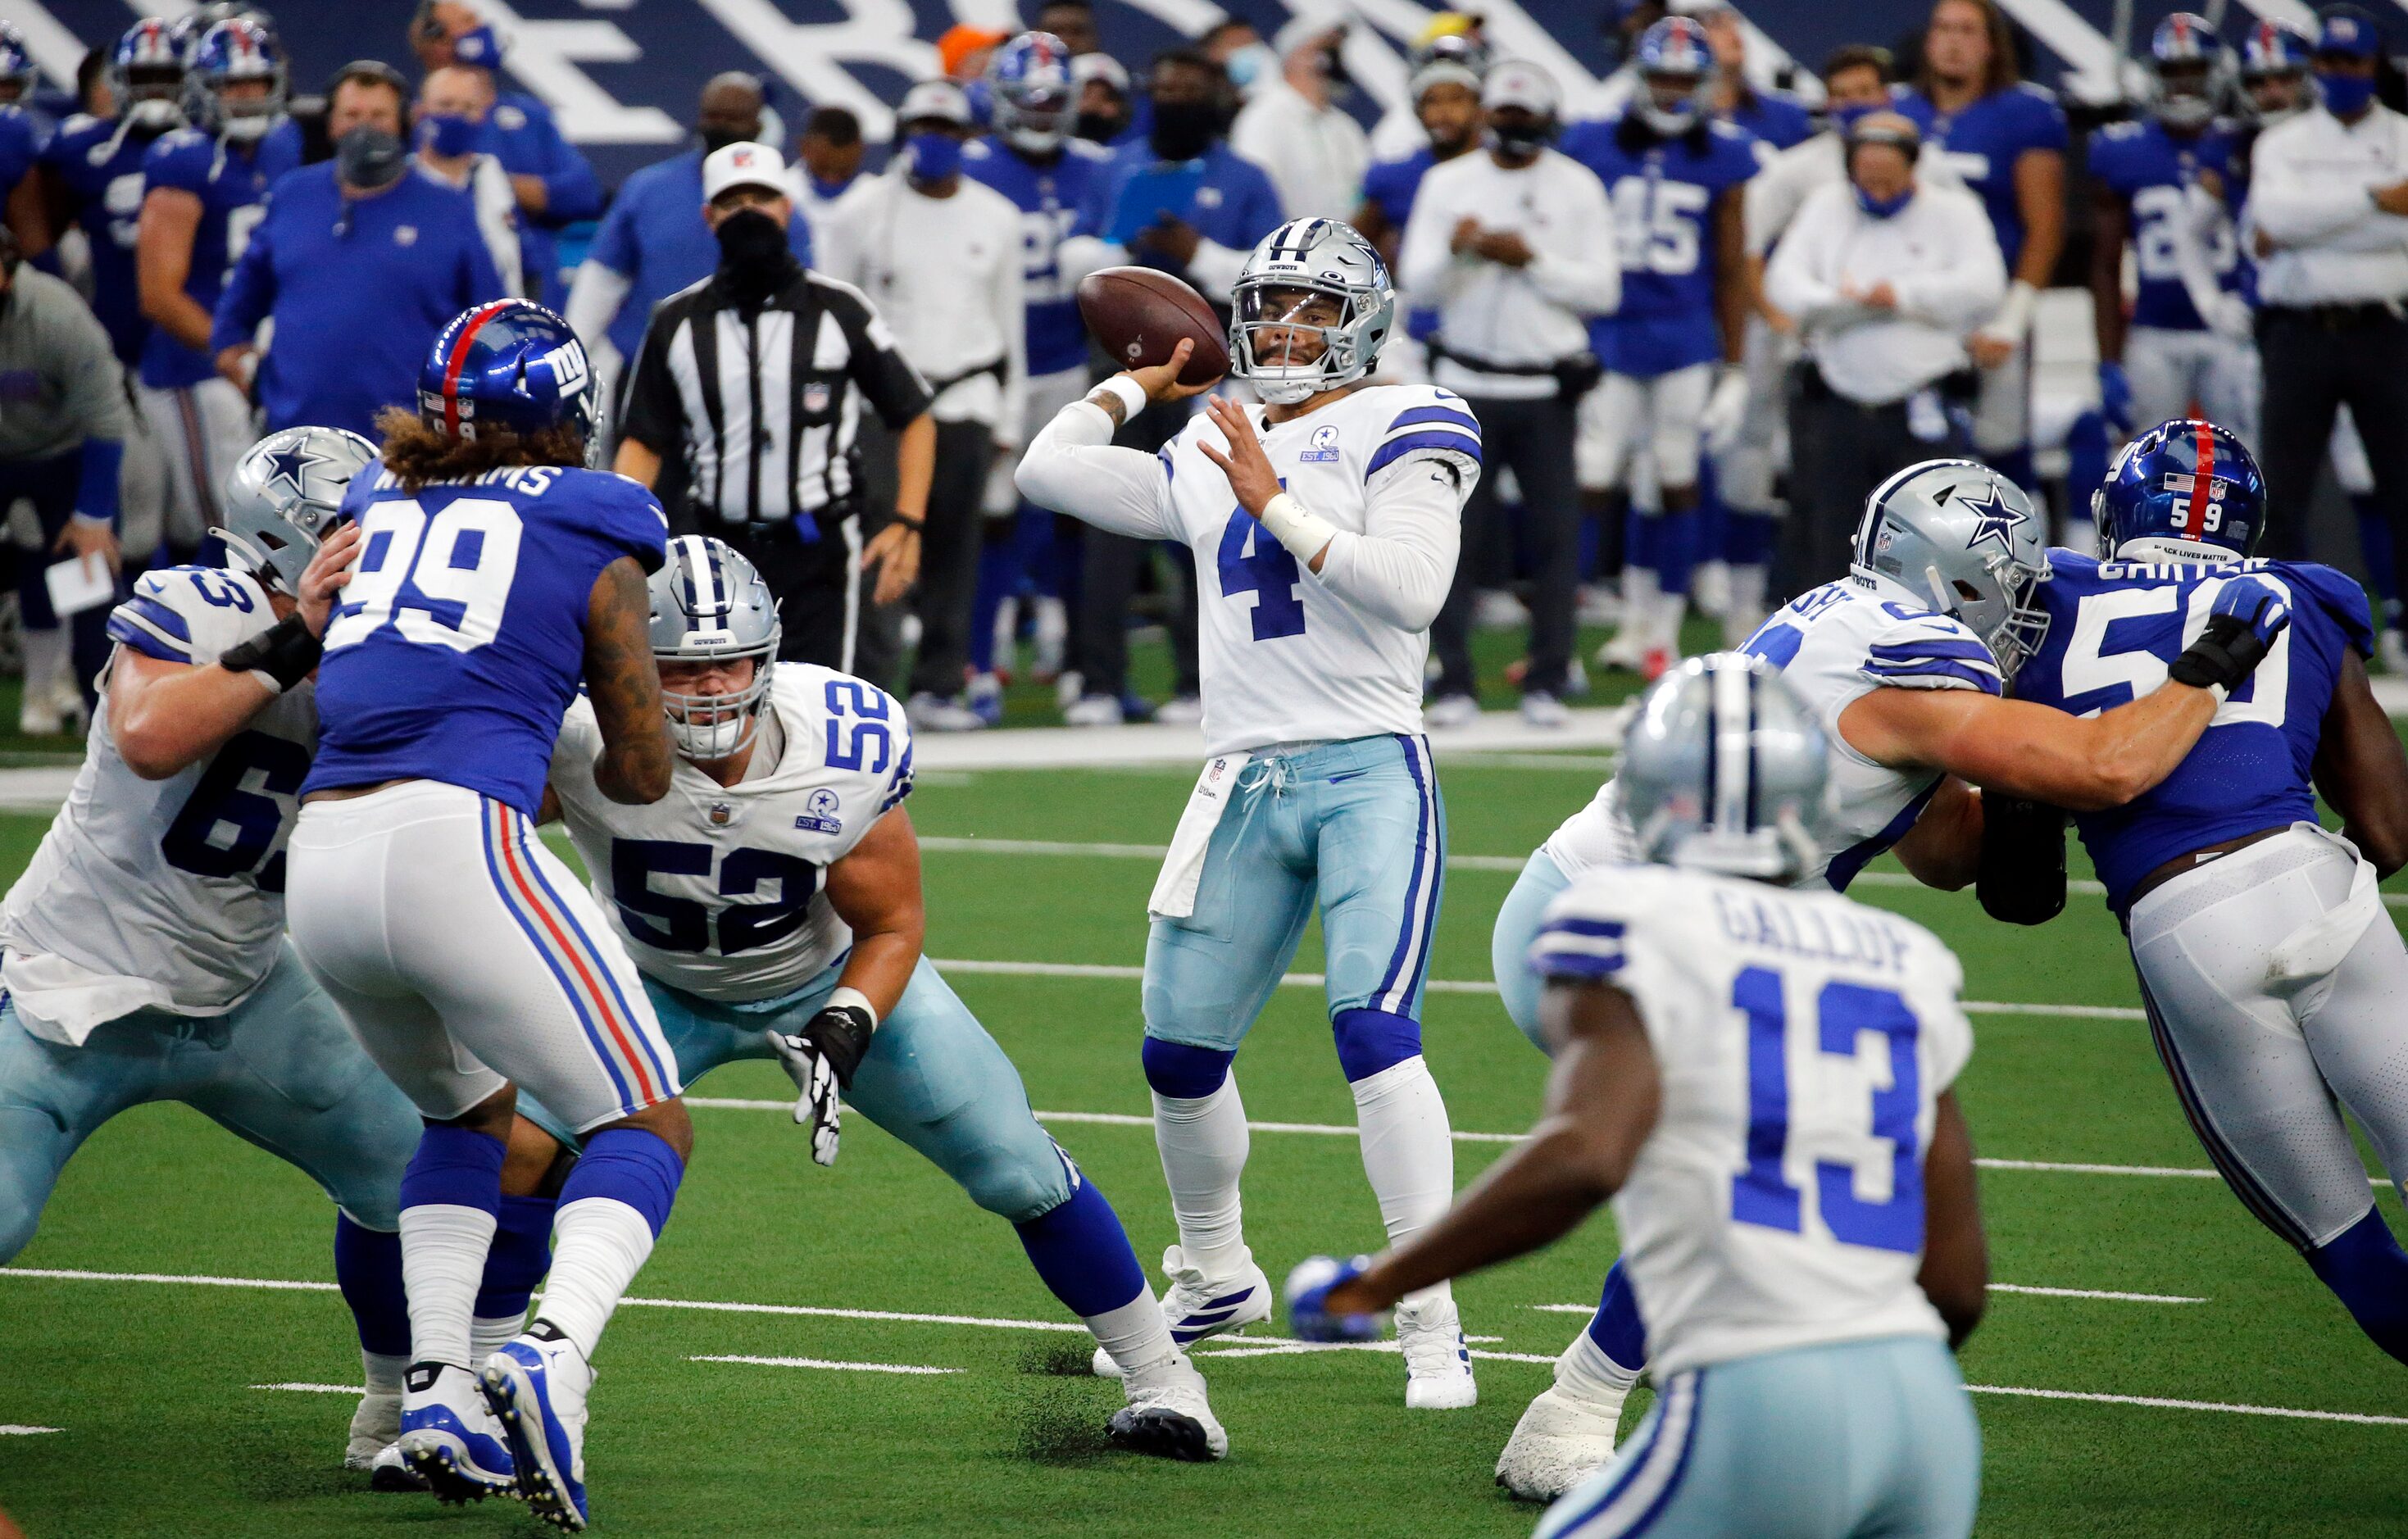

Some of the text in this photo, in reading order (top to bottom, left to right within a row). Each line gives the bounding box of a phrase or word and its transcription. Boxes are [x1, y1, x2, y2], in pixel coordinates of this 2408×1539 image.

[322, 497, 524, 654] 99
[1218, 477, 1306, 642] 4
[2170, 497, 2223, 532] 59
[2179, 550, 2201, 560] LIVES
[2202, 553, 2229, 562] MATTER
[825, 679, 890, 774] 52
[161, 729, 311, 894] 6
[611, 837, 817, 957] 52
[1731, 965, 1927, 1255] 13
